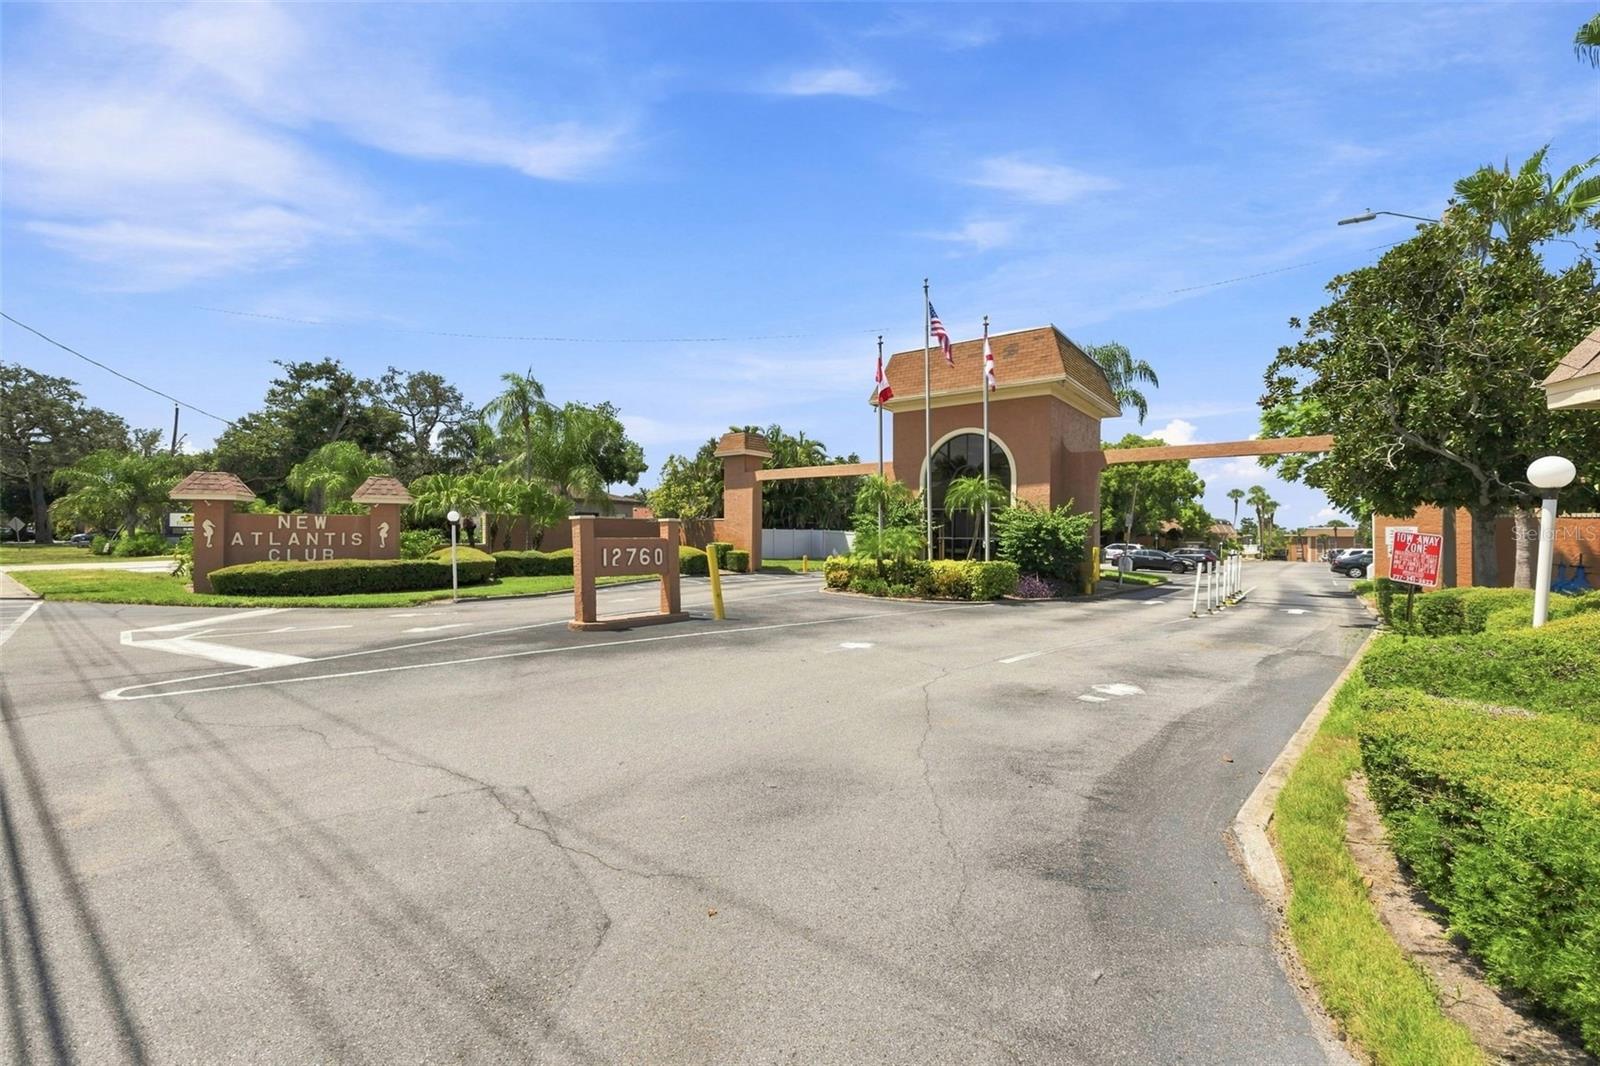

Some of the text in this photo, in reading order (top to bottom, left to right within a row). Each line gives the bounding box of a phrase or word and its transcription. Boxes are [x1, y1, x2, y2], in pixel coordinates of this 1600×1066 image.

[278, 515, 327, 529] NEW
[231, 532, 363, 546] ATLANTIS
[1396, 532, 1440, 547] TOW AWAY
[268, 548, 335, 561] CLUB
[1405, 542, 1428, 554] ZONE
[603, 548, 663, 566] 12760
